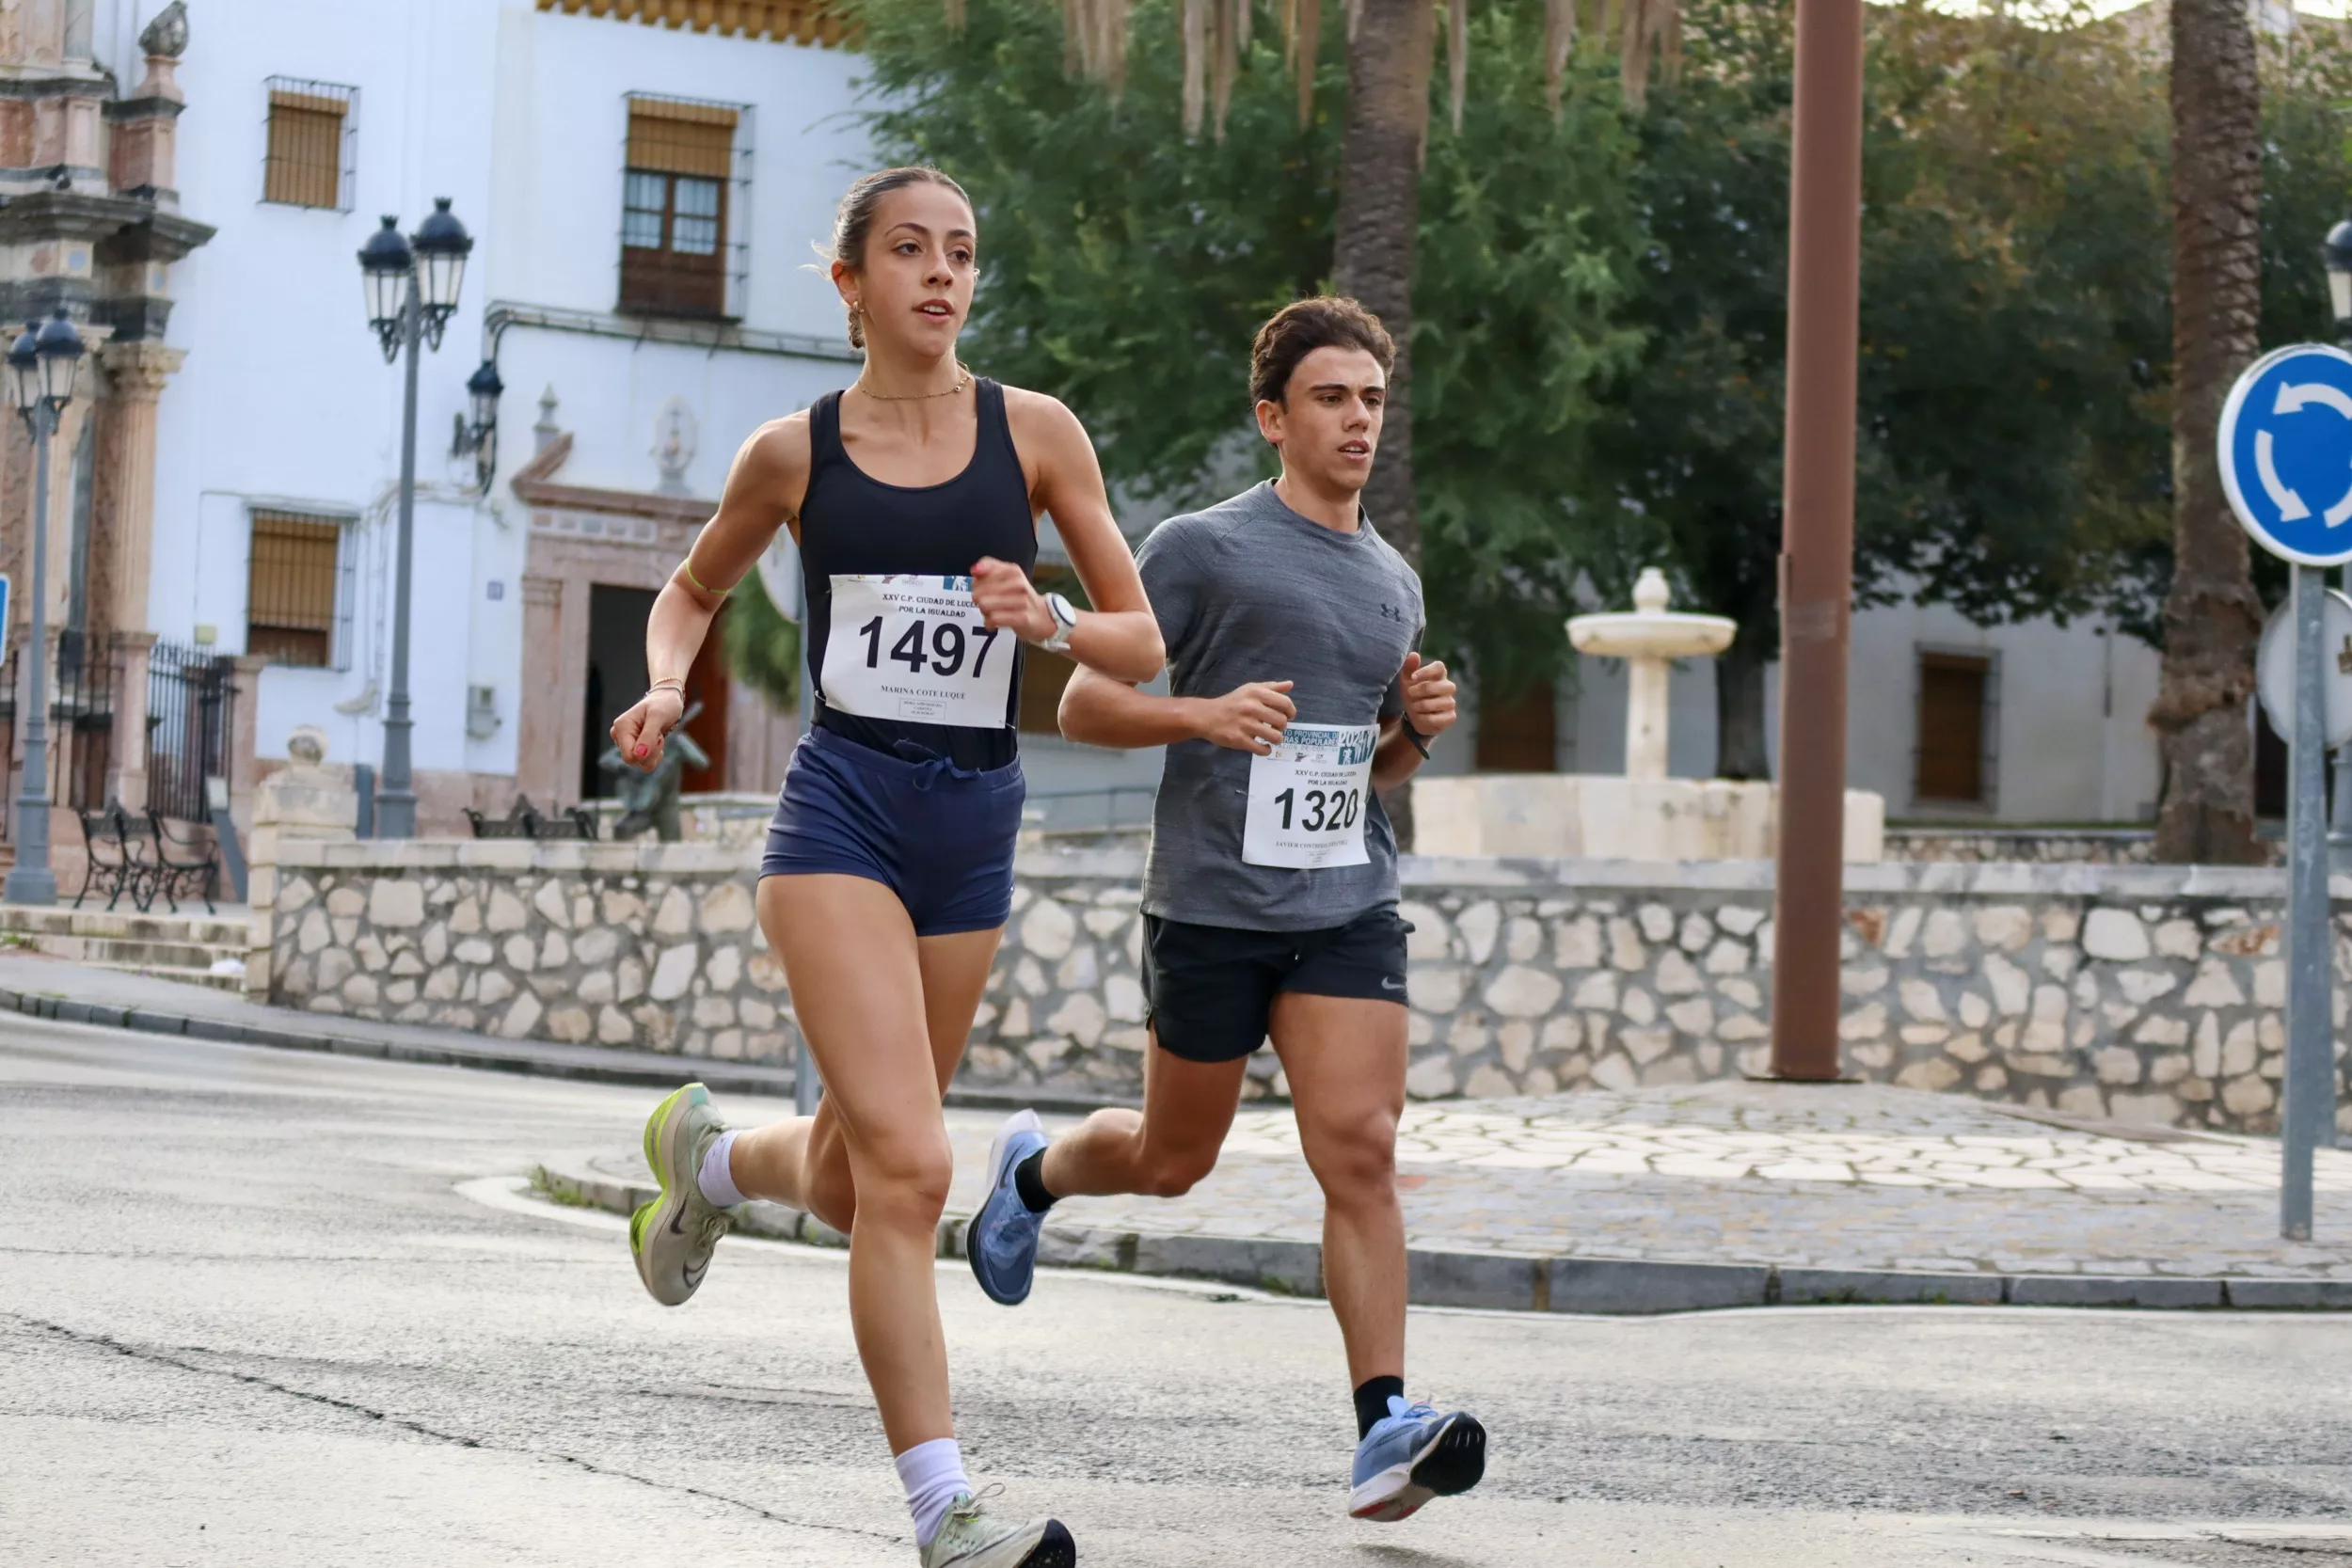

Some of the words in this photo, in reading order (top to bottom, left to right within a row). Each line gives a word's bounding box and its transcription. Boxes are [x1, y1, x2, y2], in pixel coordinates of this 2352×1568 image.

[882, 593, 899, 601] XXV
[915, 596, 945, 606] CIUDAD
[945, 598, 955, 607] DE
[898, 605, 914, 613] POR
[915, 607, 926, 615] LA
[928, 608, 966, 618] IGUALDAD
[859, 615, 998, 678] 1497
[881, 685, 914, 695] MARINA
[915, 689, 939, 698] COTE
[940, 690, 966, 701] LUQUE
[1294, 730, 1330, 740] PROVINCIAL
[1300, 737, 1340, 747] POPULARES
[1275, 787, 1359, 832] 1320
